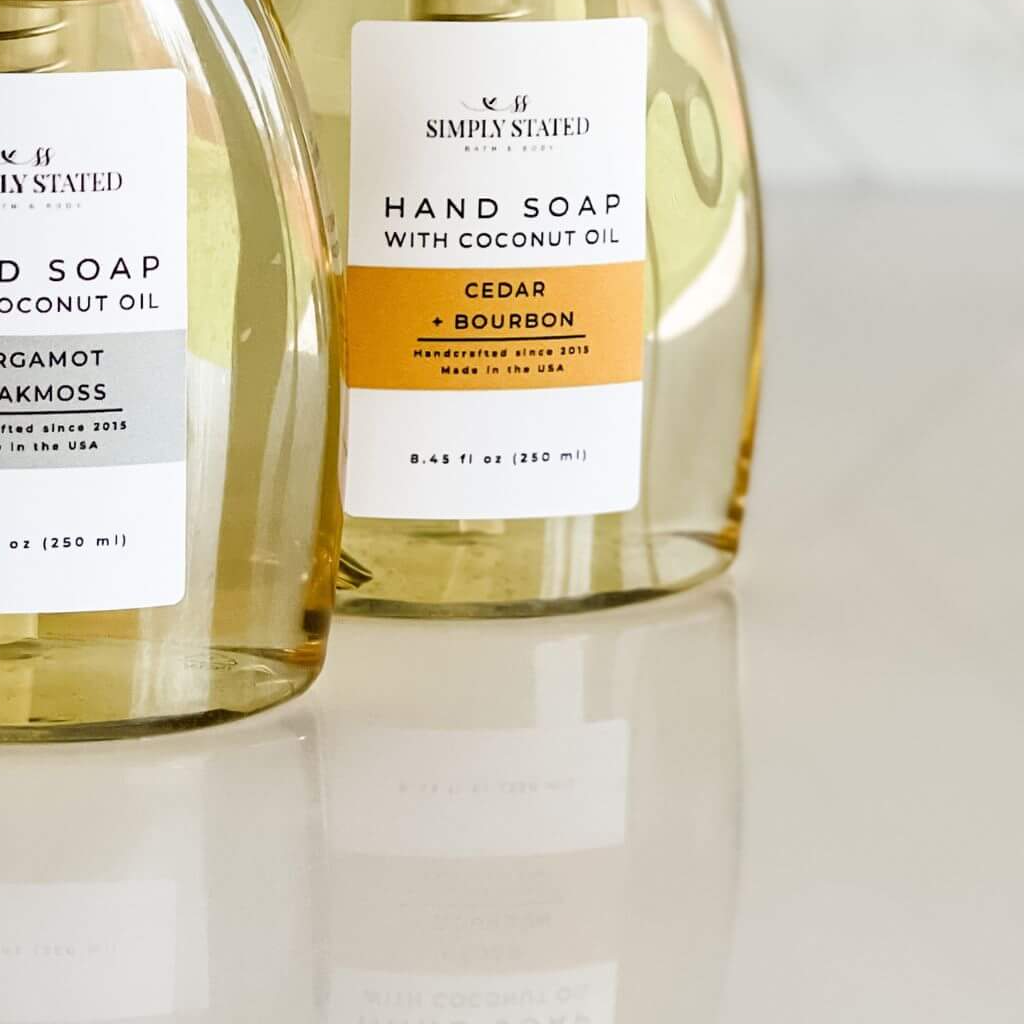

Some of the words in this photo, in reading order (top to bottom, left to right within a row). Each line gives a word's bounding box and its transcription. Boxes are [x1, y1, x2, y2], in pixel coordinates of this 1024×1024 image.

[427, 120, 505, 138] SIMPLY
[512, 117, 589, 137] STATED
[34, 172, 122, 193] STATED
[386, 197, 498, 219] HAND
[524, 194, 620, 218] SOAP
[385, 232, 447, 248] WITH
[459, 231, 576, 248] COCONUT
[585, 229, 618, 244] OIL
[49, 256, 159, 281] SOAP
[465, 281, 545, 298] CEDAR
[120, 293, 158, 310] OIL
[431, 316, 444, 328] +
[455, 312, 573, 329] BOURBON
[413, 348, 508, 359] Handcrafted
[515, 347, 554, 358] since
[559, 344, 590, 356] 2015
[440, 365, 479, 375] Made
[486, 364, 500, 375] in
[506, 364, 531, 374] the
[537, 363, 564, 374] USA
[42, 422, 85, 434] since
[93, 420, 127, 432] 2015
[10, 441, 25, 452] in
[33, 441, 59, 452] the
[68, 440, 99, 451] USA
[410, 453, 450, 465] 8.45
[460, 453, 473, 465] fl
[483, 455, 502, 465] oz
[512, 451, 550, 466] (250
[560, 449, 587, 461] ml)
[9, 539, 30, 550] oz
[42, 536, 85, 551] (250
[96, 533, 126, 548] ml)
